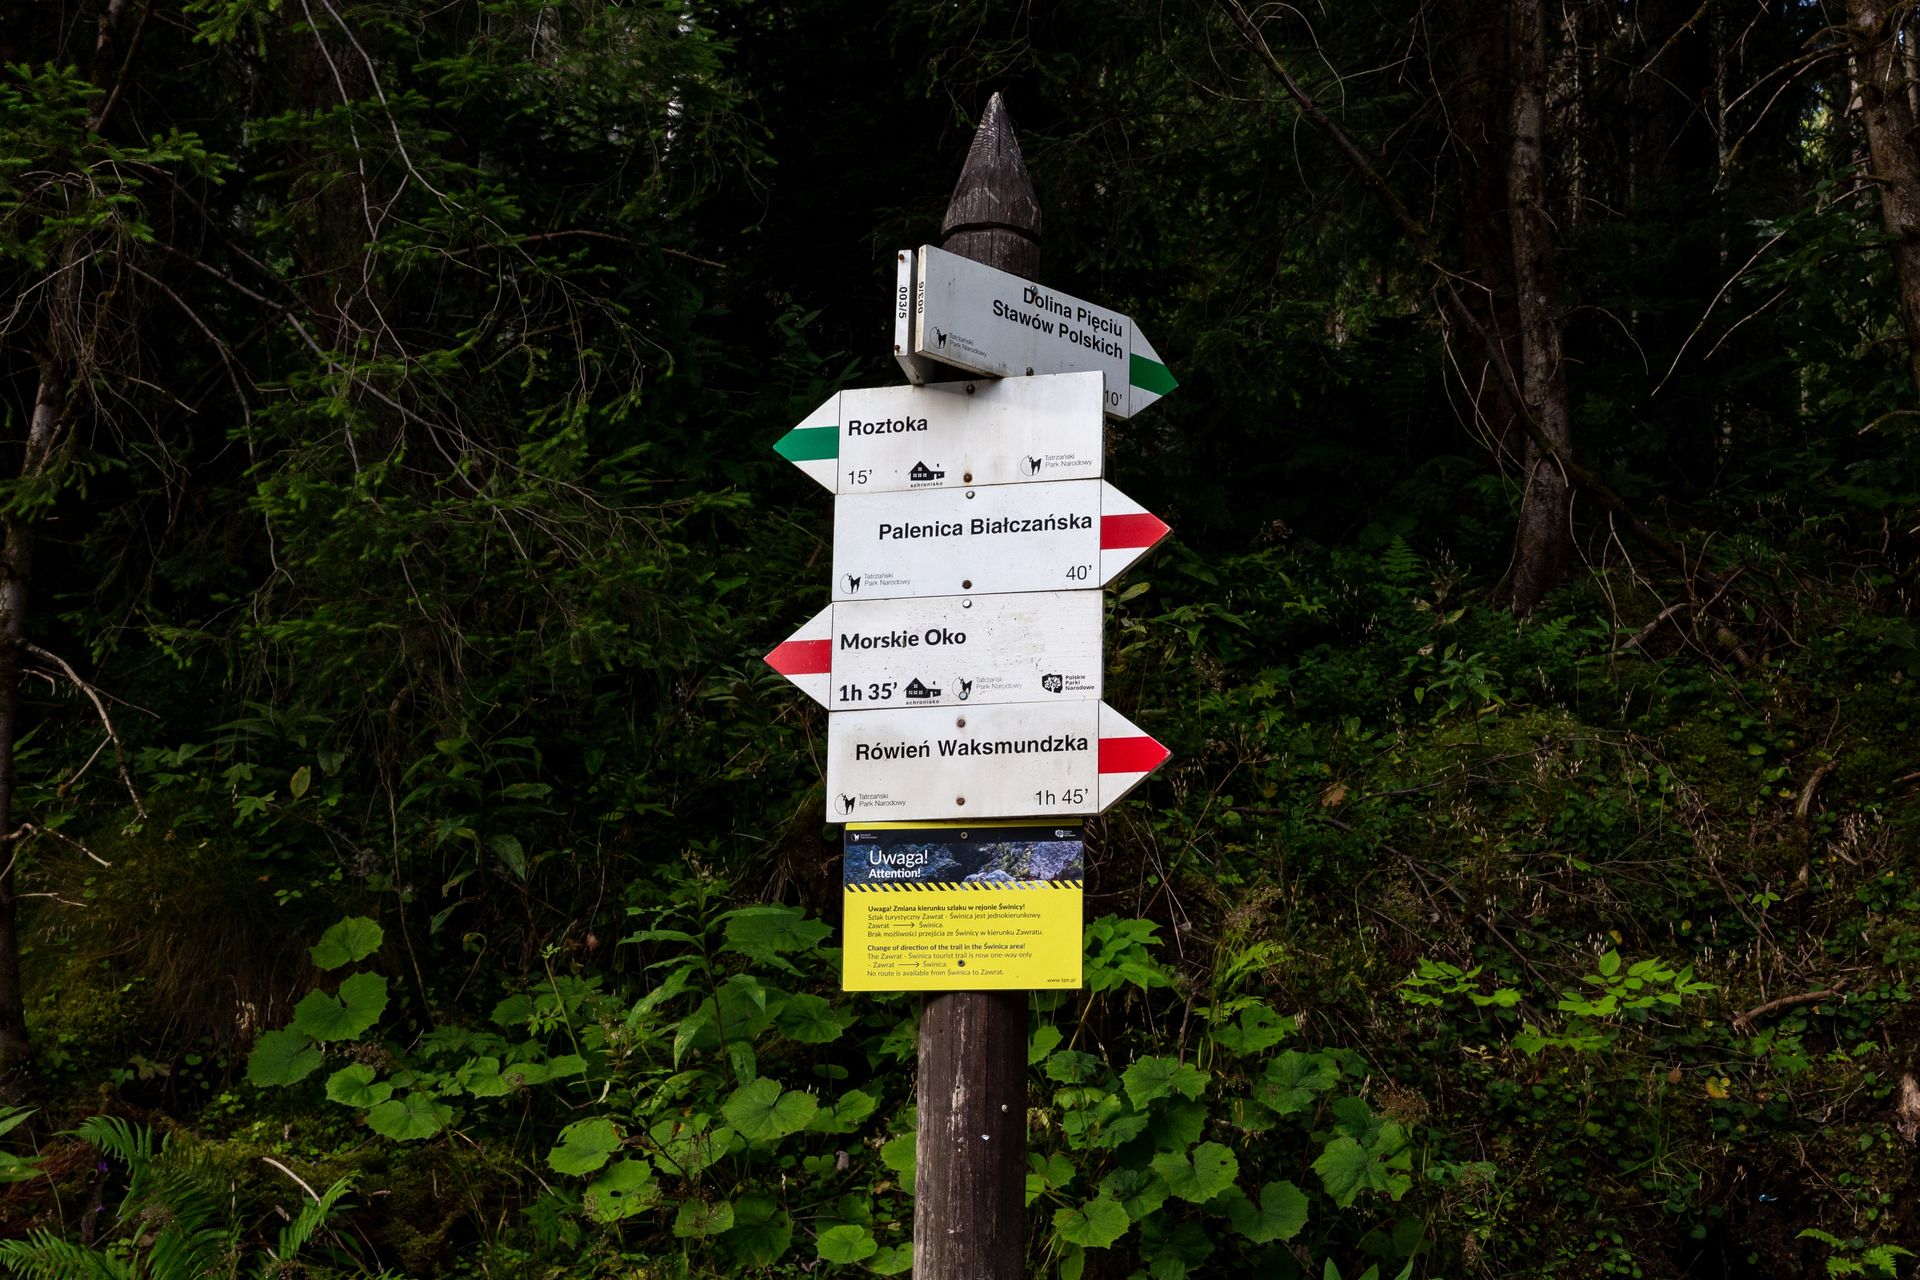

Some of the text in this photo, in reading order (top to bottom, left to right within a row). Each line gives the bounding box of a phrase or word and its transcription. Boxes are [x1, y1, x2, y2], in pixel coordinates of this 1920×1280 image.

[899, 286, 908, 319] 003/5
[1023, 287, 1122, 337] Dolina Pięciu
[993, 299, 1123, 360] Stawów Polskich
[848, 416, 928, 436] Roztoka
[879, 514, 1092, 540] Palenica Białczańska
[840, 628, 967, 650] Morskie Oko
[839, 684, 862, 701] 1h
[855, 735, 1088, 760] Rówień Waksmundzka
[1035, 790, 1055, 805] 1h
[869, 849, 928, 868] Uwaga!
[868, 868, 921, 878] Attention!
[999, 902, 1025, 911] Świnicy!
[918, 930, 945, 938] przejścia
[867, 944, 891, 952] Change
[983, 942, 1008, 950] Świnica
[1018, 951, 1033, 959] only
[947, 968, 971, 976] Świnica
